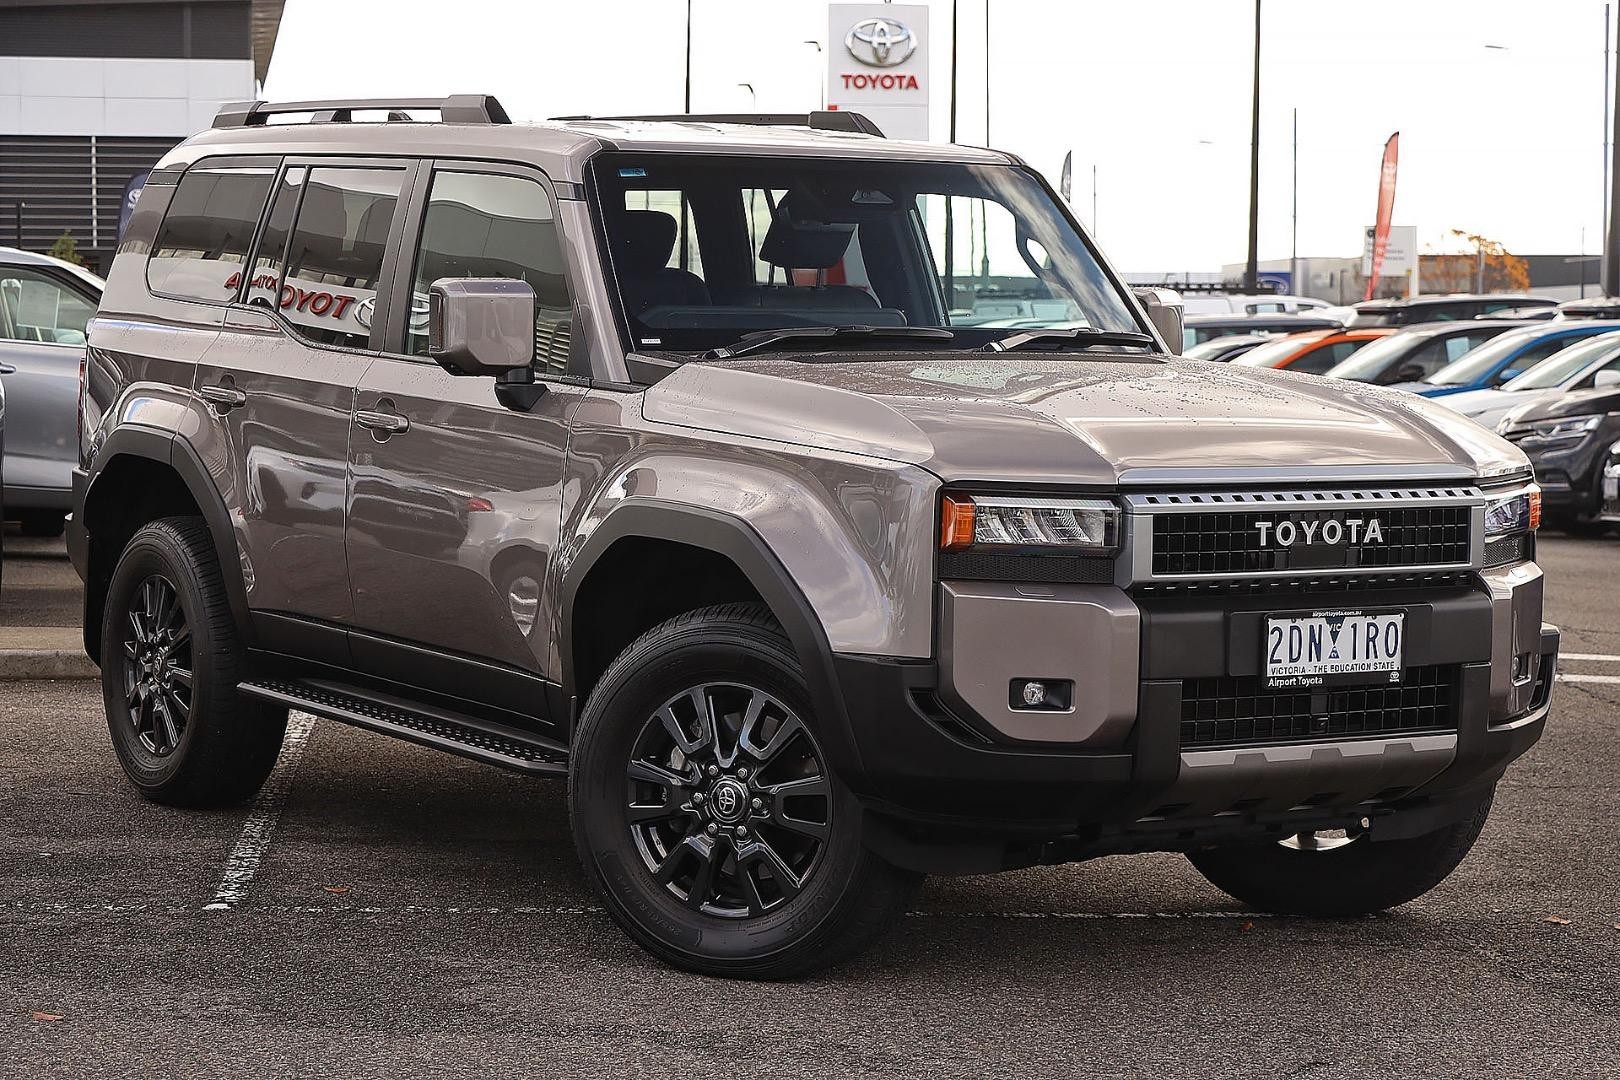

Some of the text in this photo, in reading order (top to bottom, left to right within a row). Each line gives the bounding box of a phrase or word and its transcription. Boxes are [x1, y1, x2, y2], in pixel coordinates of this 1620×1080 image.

[841, 74, 918, 90] TOYOTA
[1255, 519, 1383, 546] TOYOTA
[1269, 624, 1322, 664] 2DN
[1271, 666, 1306, 675] VICTORIA
[1313, 664, 1328, 673] THE
[1330, 662, 1372, 672] EDUCATION
[1373, 661, 1395, 670] STATE
[1268, 676, 1323, 688] Airport Toyota
